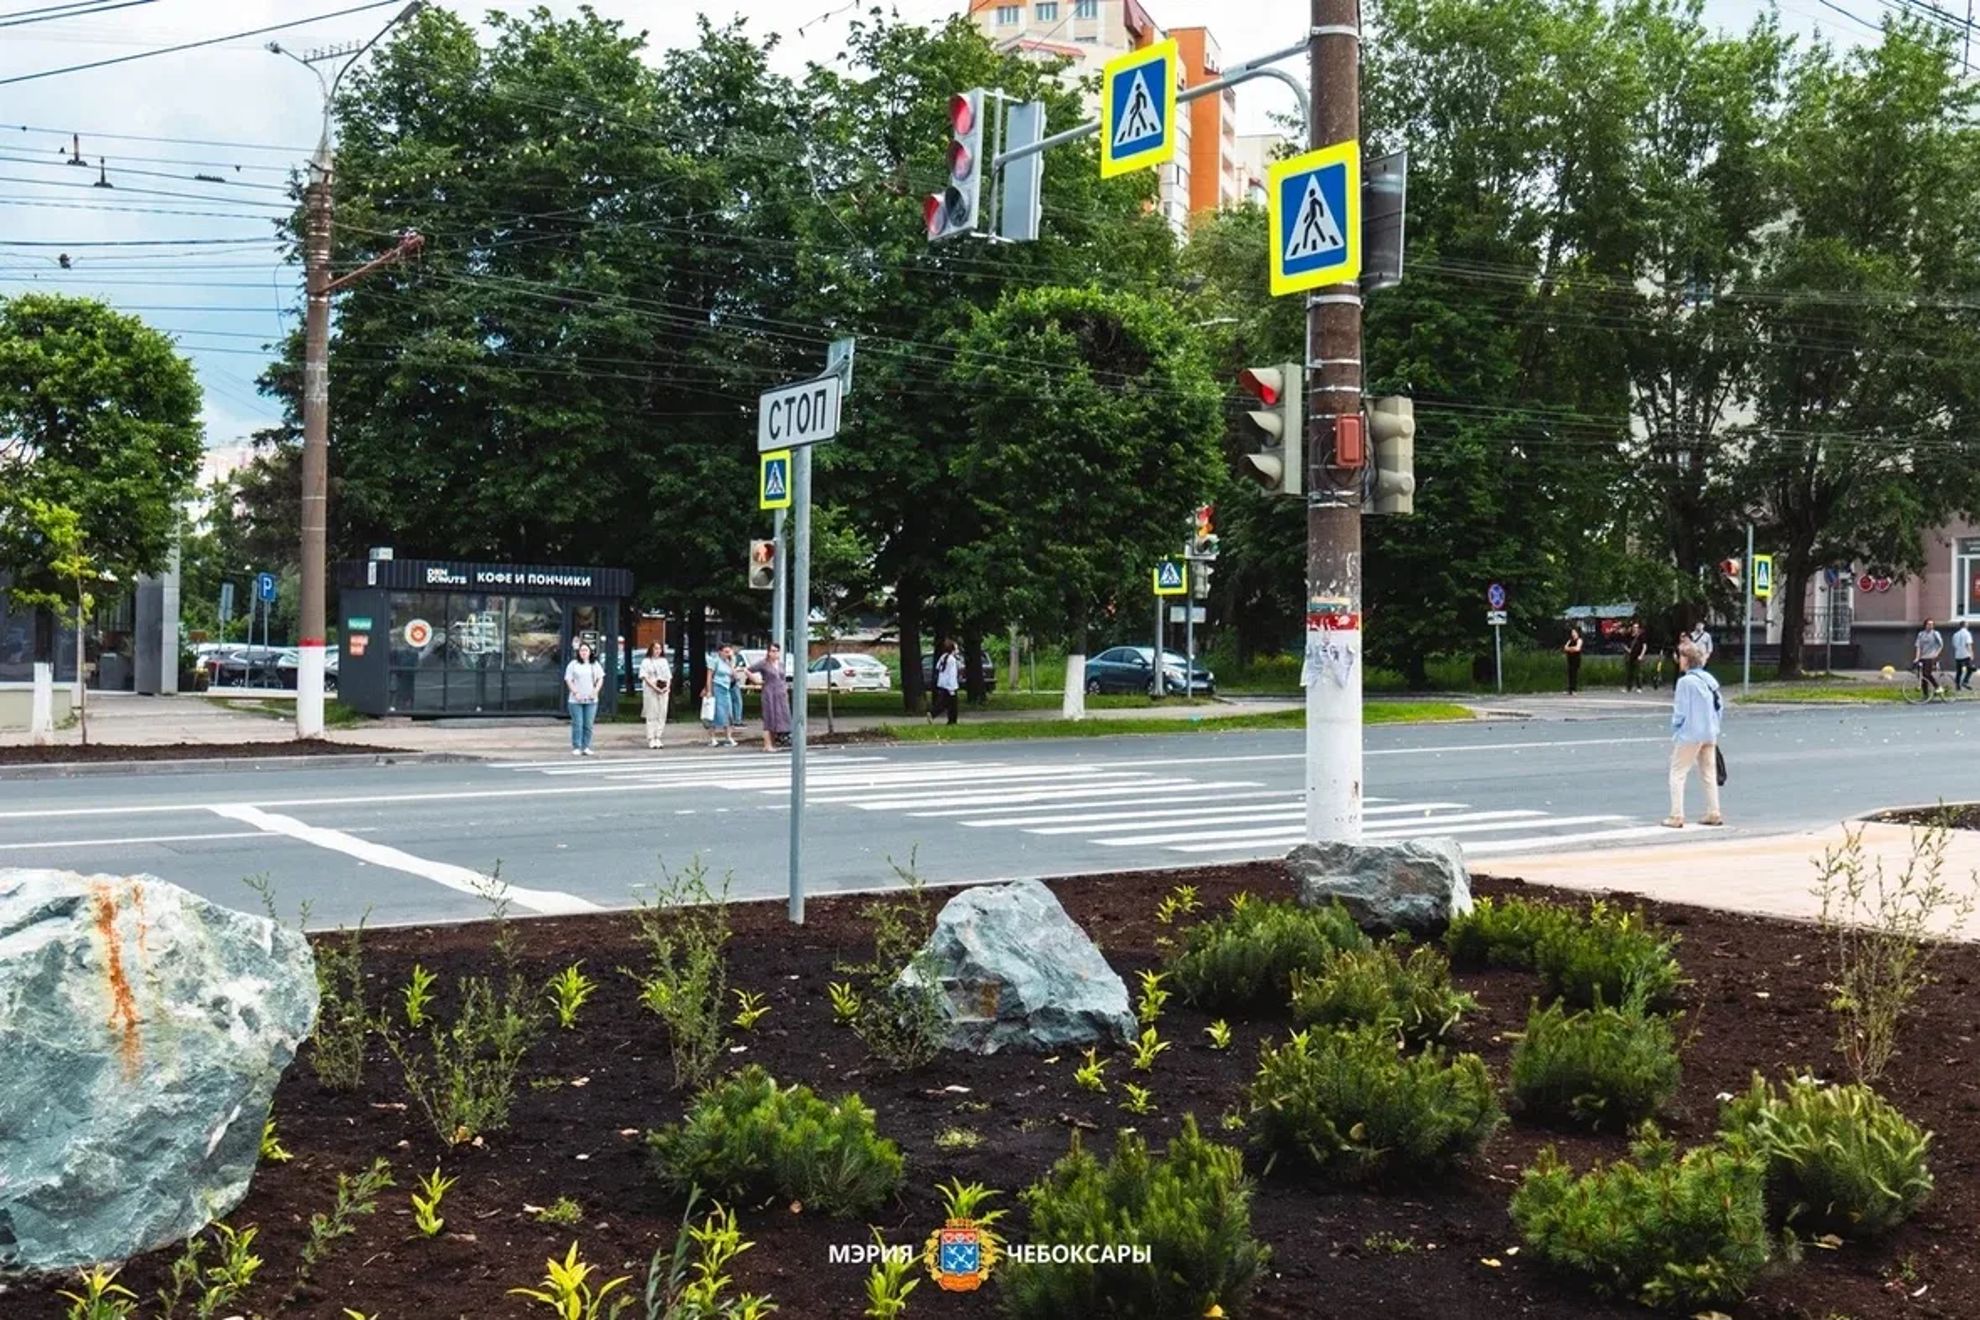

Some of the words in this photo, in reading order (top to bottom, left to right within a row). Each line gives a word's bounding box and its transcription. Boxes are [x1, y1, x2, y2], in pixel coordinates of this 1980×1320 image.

[769, 389, 826, 440] СТОП
[263, 577, 273, 597] P
[477, 572, 512, 584] КОФЕ
[515, 573, 525, 584] И
[528, 573, 592, 587] ПОНЧИКИ
